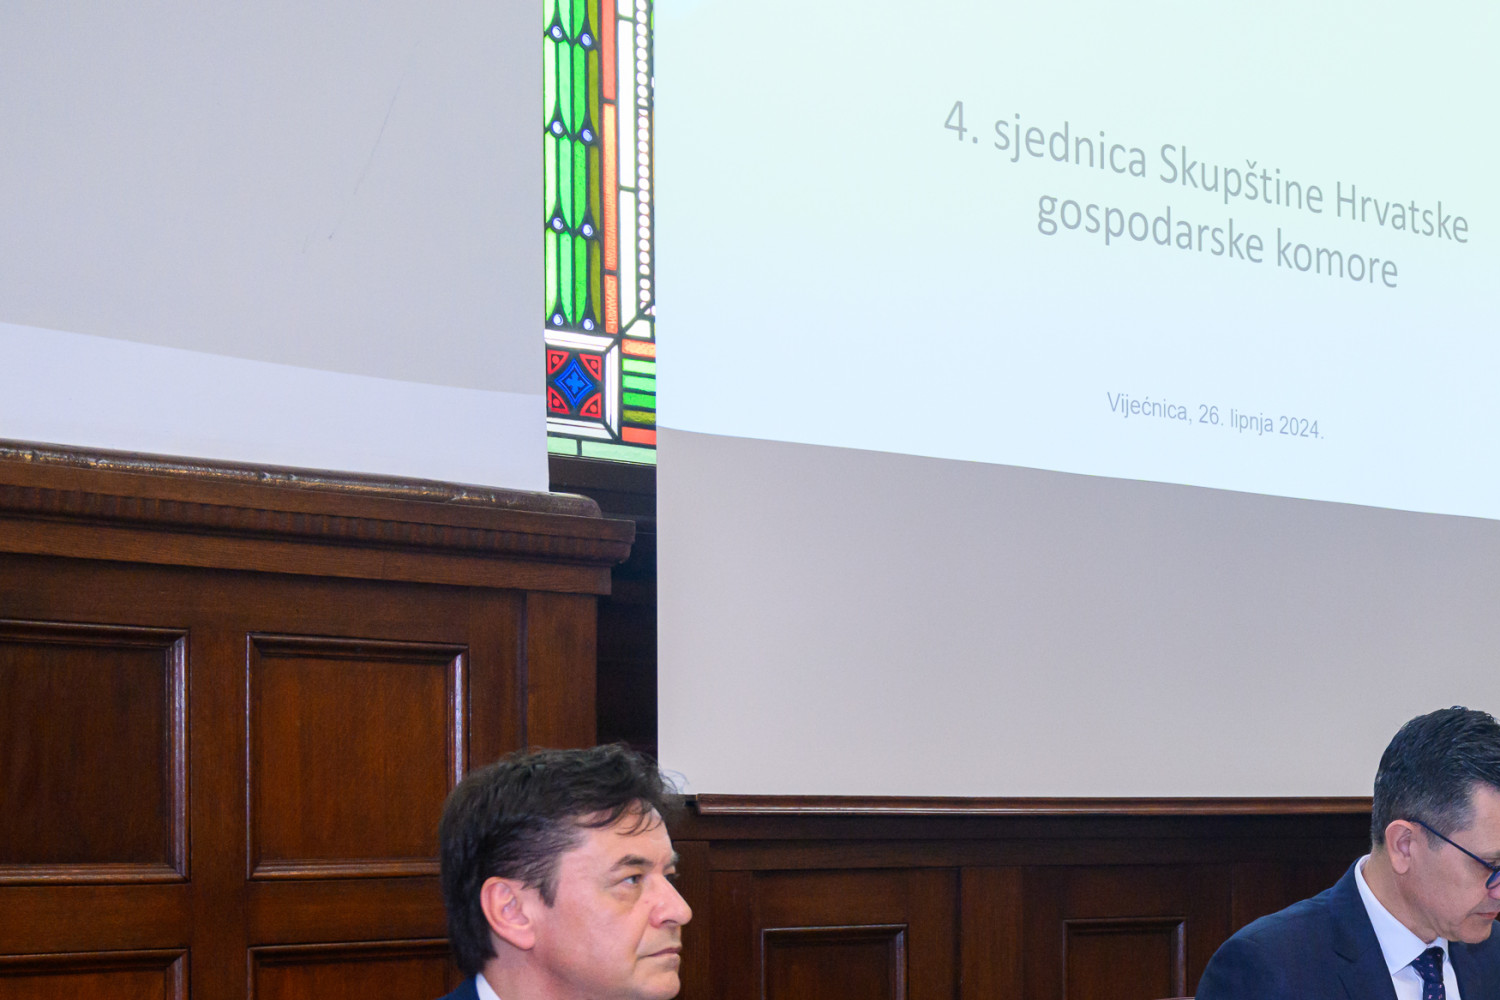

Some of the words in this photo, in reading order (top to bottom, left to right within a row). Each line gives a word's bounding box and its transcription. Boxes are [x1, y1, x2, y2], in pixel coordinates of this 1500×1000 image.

[944, 100, 979, 145] 4.
[994, 112, 1146, 178] sjednica
[1159, 143, 1324, 214] Skupštine
[1336, 181, 1469, 244] Hrvatske
[1037, 194, 1264, 264] gospodarske
[1276, 227, 1398, 288] komore
[1107, 391, 1193, 425] Vijećnica,
[1199, 404, 1224, 427] 26.
[1230, 408, 1274, 436] lipnja
[1279, 415, 1325, 440] 2024.
